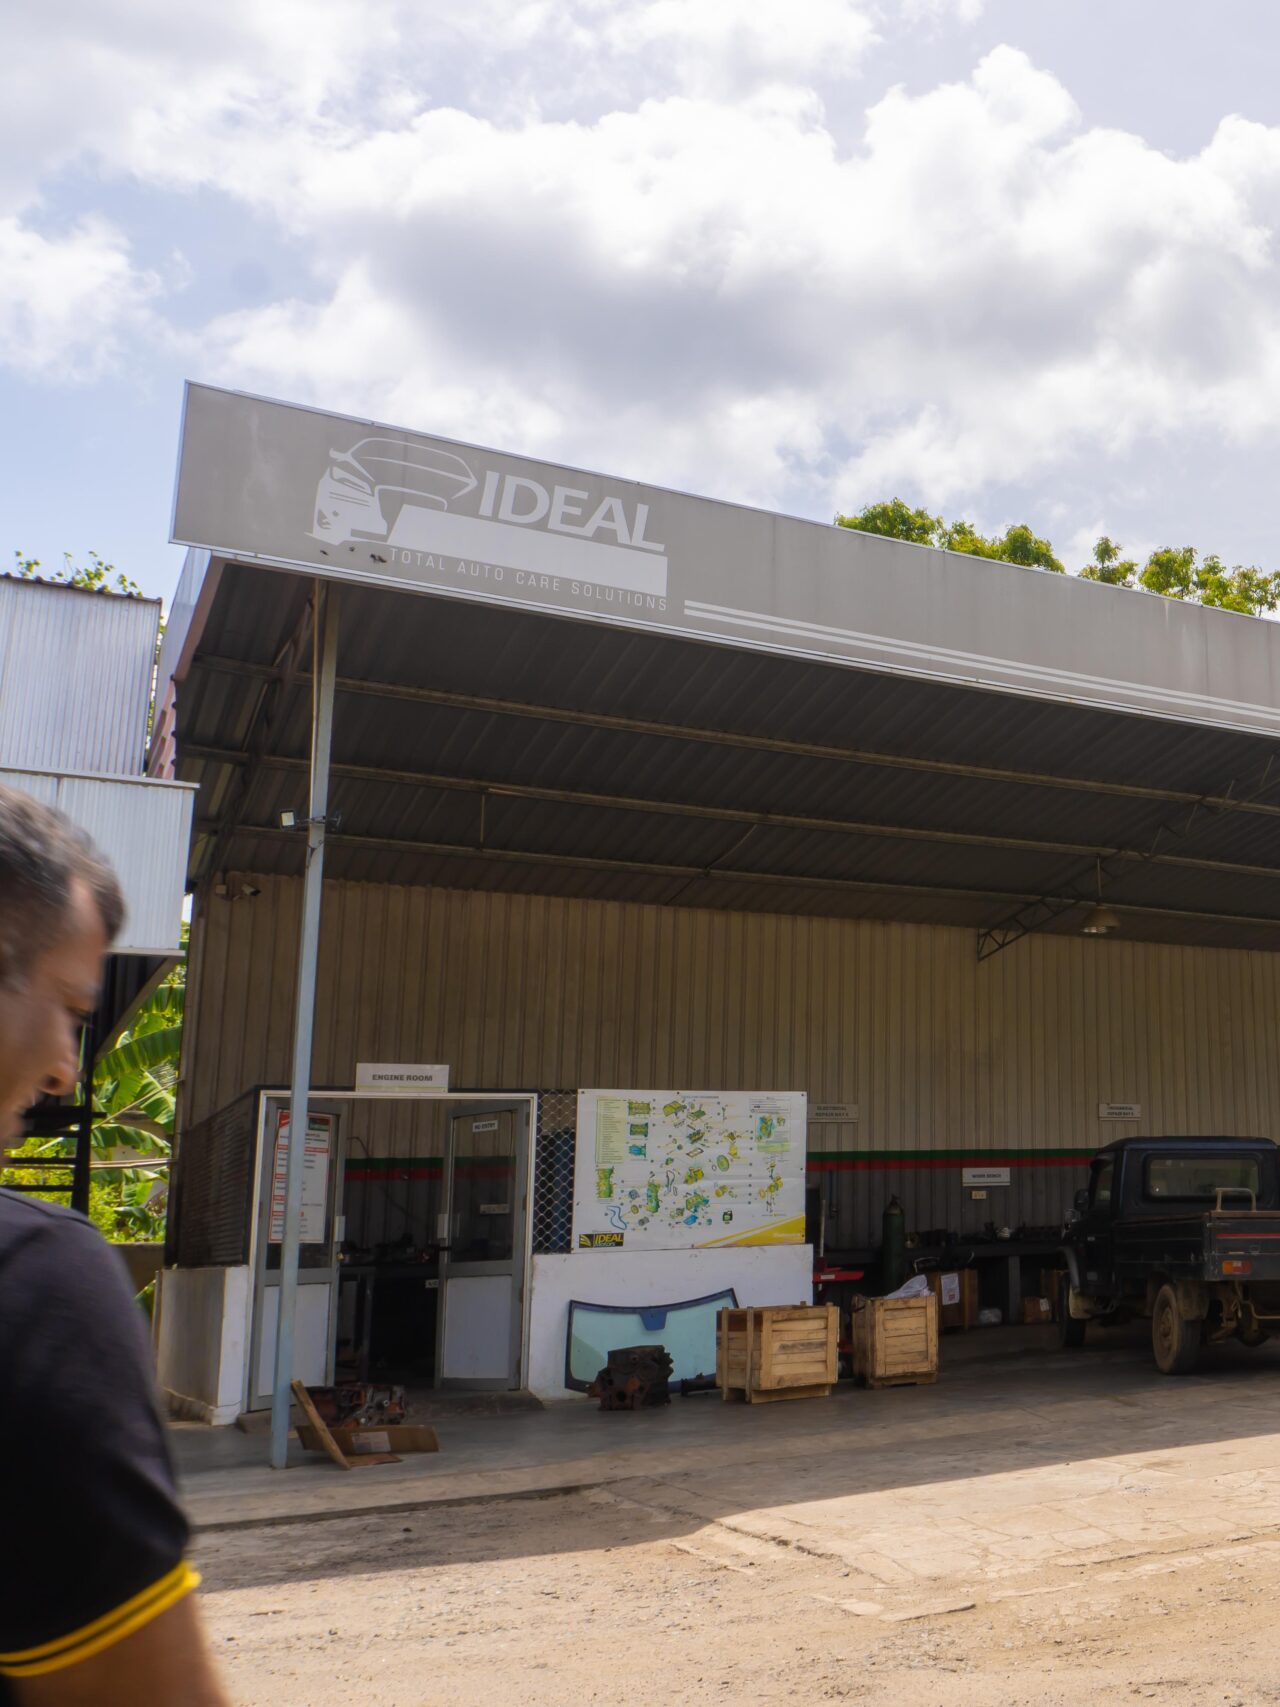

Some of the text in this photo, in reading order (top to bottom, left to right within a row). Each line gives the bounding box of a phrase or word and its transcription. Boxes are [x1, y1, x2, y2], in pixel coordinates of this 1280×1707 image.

[478, 469, 665, 552] IDEAL
[389, 547, 667, 611] TOTAL AUTO CARE SOLUTIONS
[405, 1074, 433, 1082] ROOM
[594, 1233, 625, 1244] IDEAL
